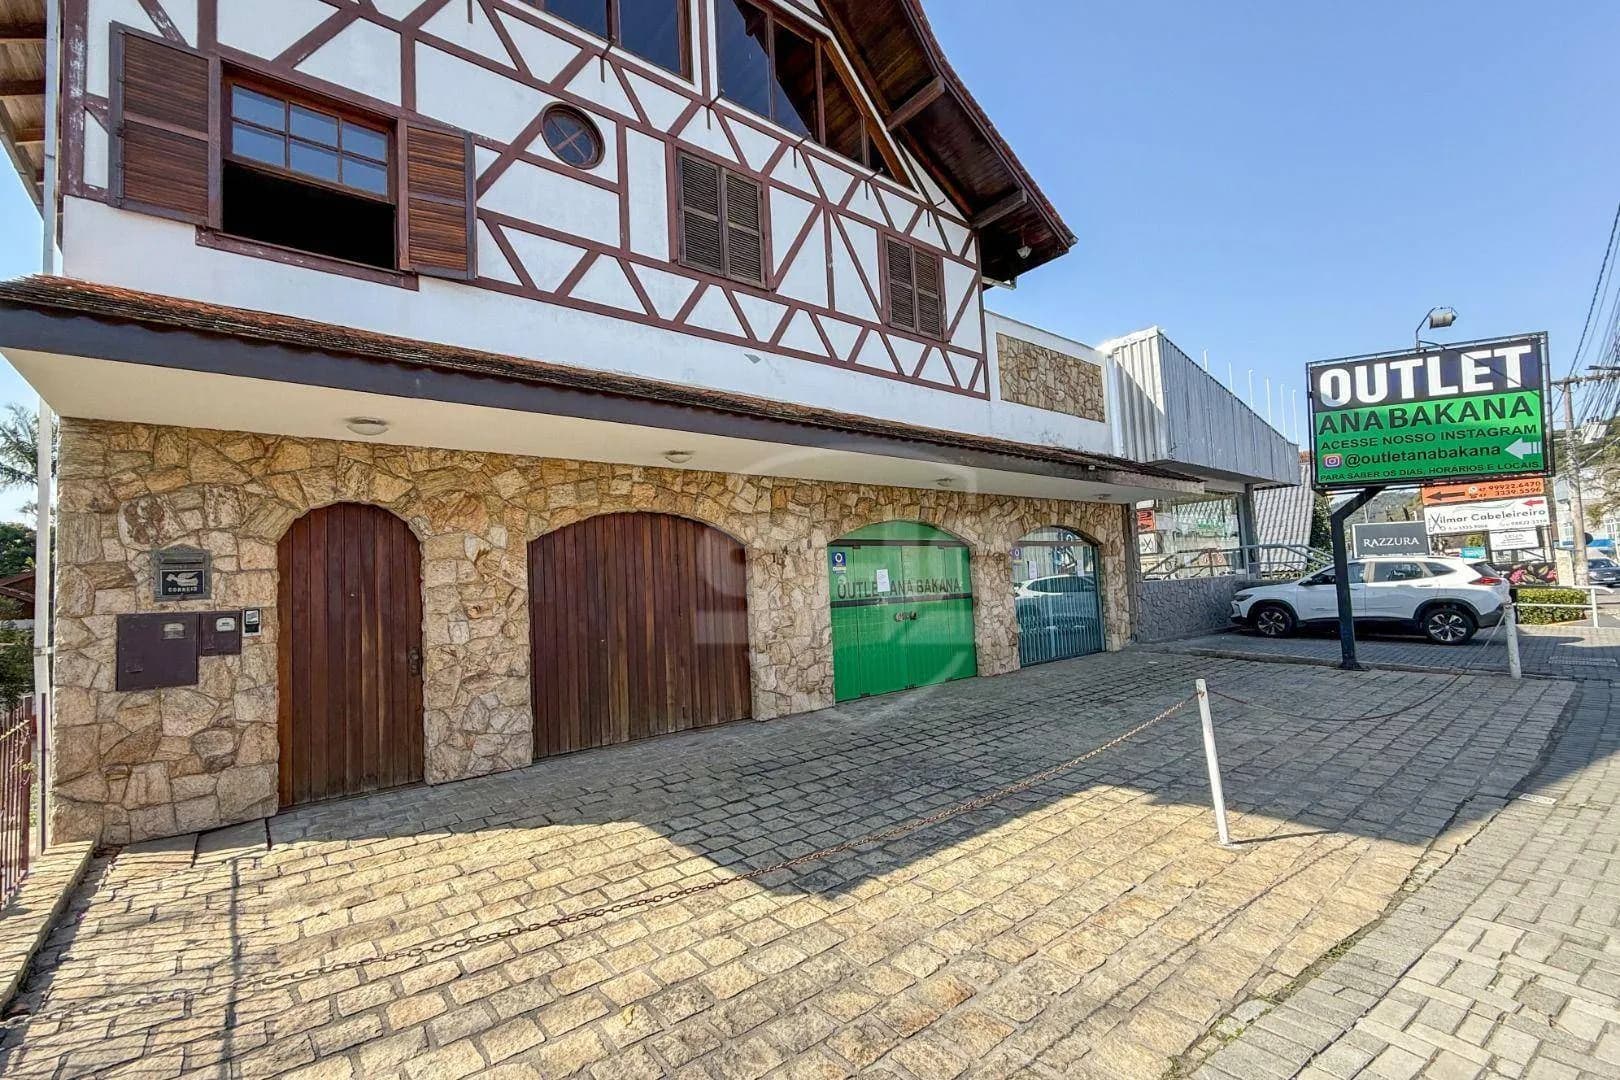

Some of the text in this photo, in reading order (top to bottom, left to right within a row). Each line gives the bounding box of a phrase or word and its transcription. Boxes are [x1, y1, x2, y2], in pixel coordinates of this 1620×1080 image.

[1319, 345, 1532, 407] OUTLET
[1318, 395, 1534, 435] ANA BAKANA
[1321, 424, 1537, 451] ACESSE NOSSO INSTAGRAM
[1344, 444, 1501, 469] @outletanabakana
[1320, 473, 1346, 482] PARA
[1346, 470, 1380, 480] SABER
[1382, 469, 1396, 478] OS
[1486, 463, 1494, 471] E
[1471, 509, 1545, 522] Cabeleireiro
[1363, 537, 1419, 548] RAZZURA
[837, 581, 885, 599] OUTLE
[890, 579, 914, 596] ANA
[917, 577, 961, 593] BAKANA
